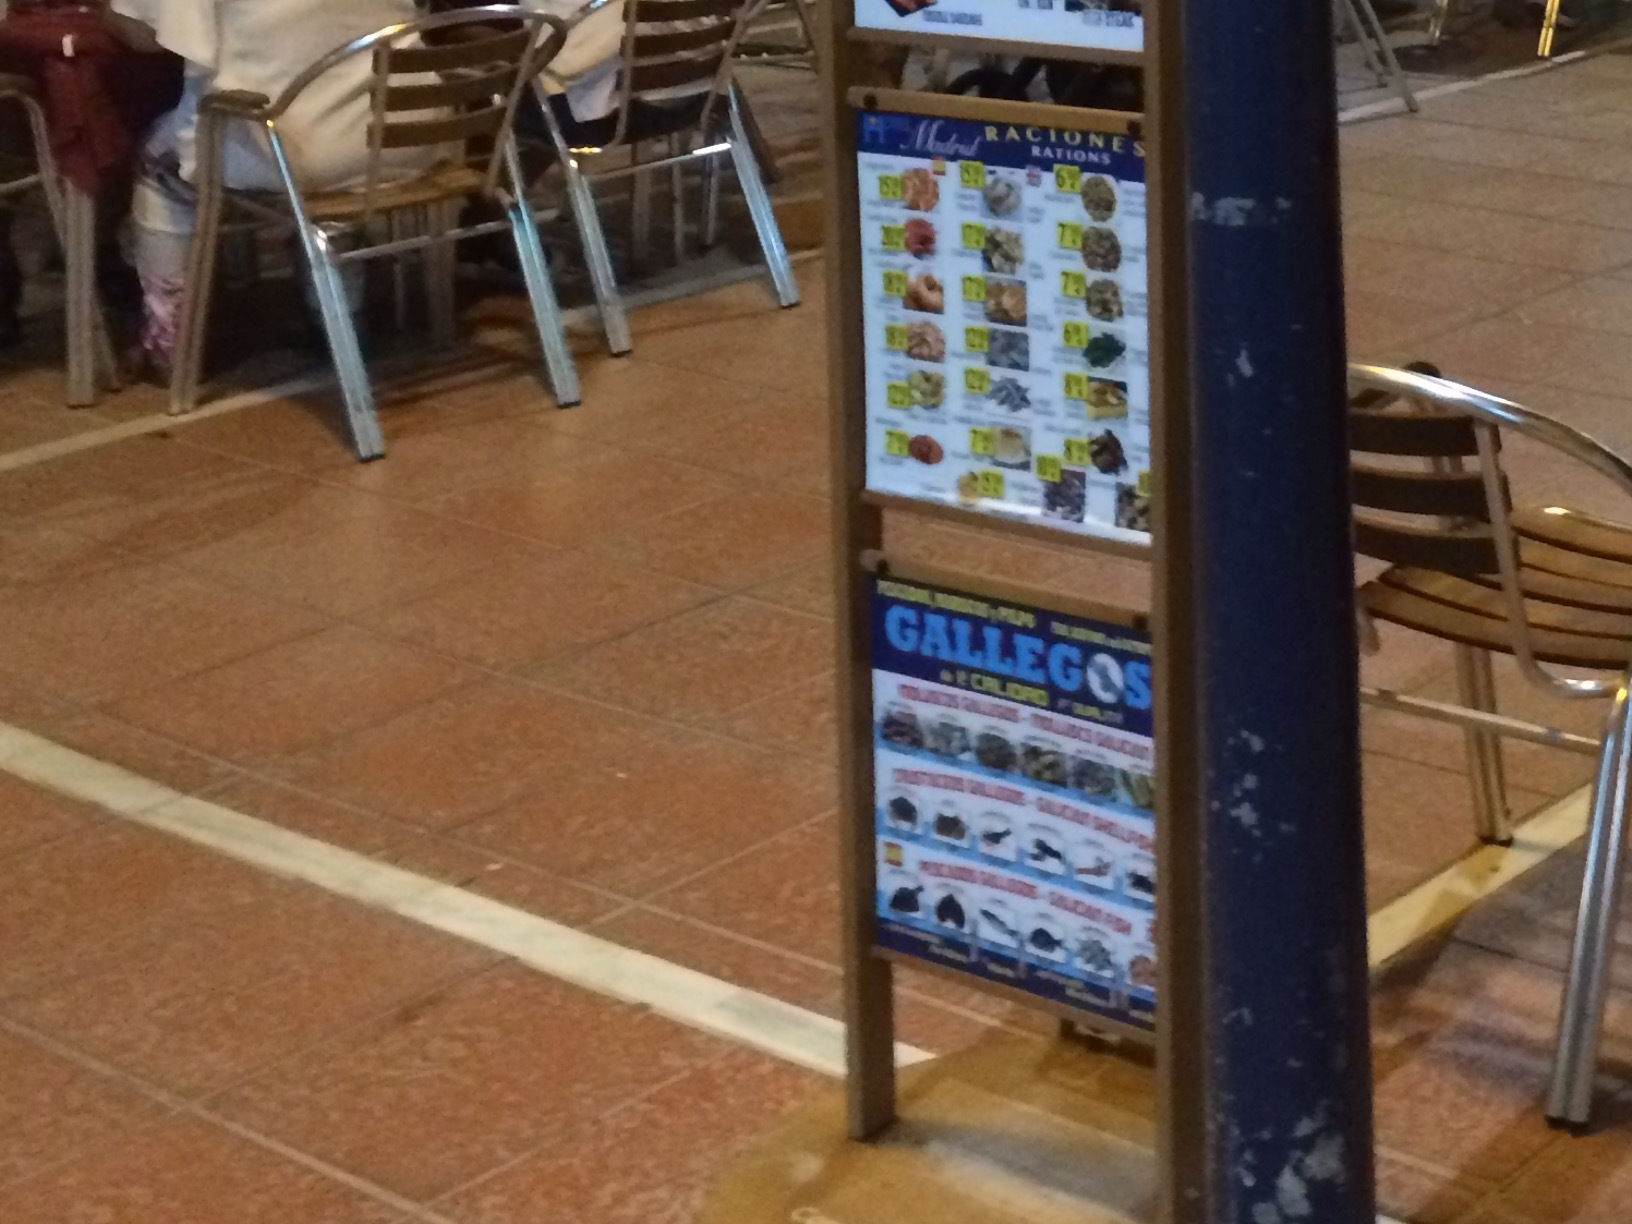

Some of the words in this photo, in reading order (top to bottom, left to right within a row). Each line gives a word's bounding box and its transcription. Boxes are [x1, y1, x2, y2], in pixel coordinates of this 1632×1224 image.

[984, 125, 1146, 158] RACIONES
[1031, 144, 1112, 165] RATIONS
[885, 604, 1151, 710] GALLEGOS
